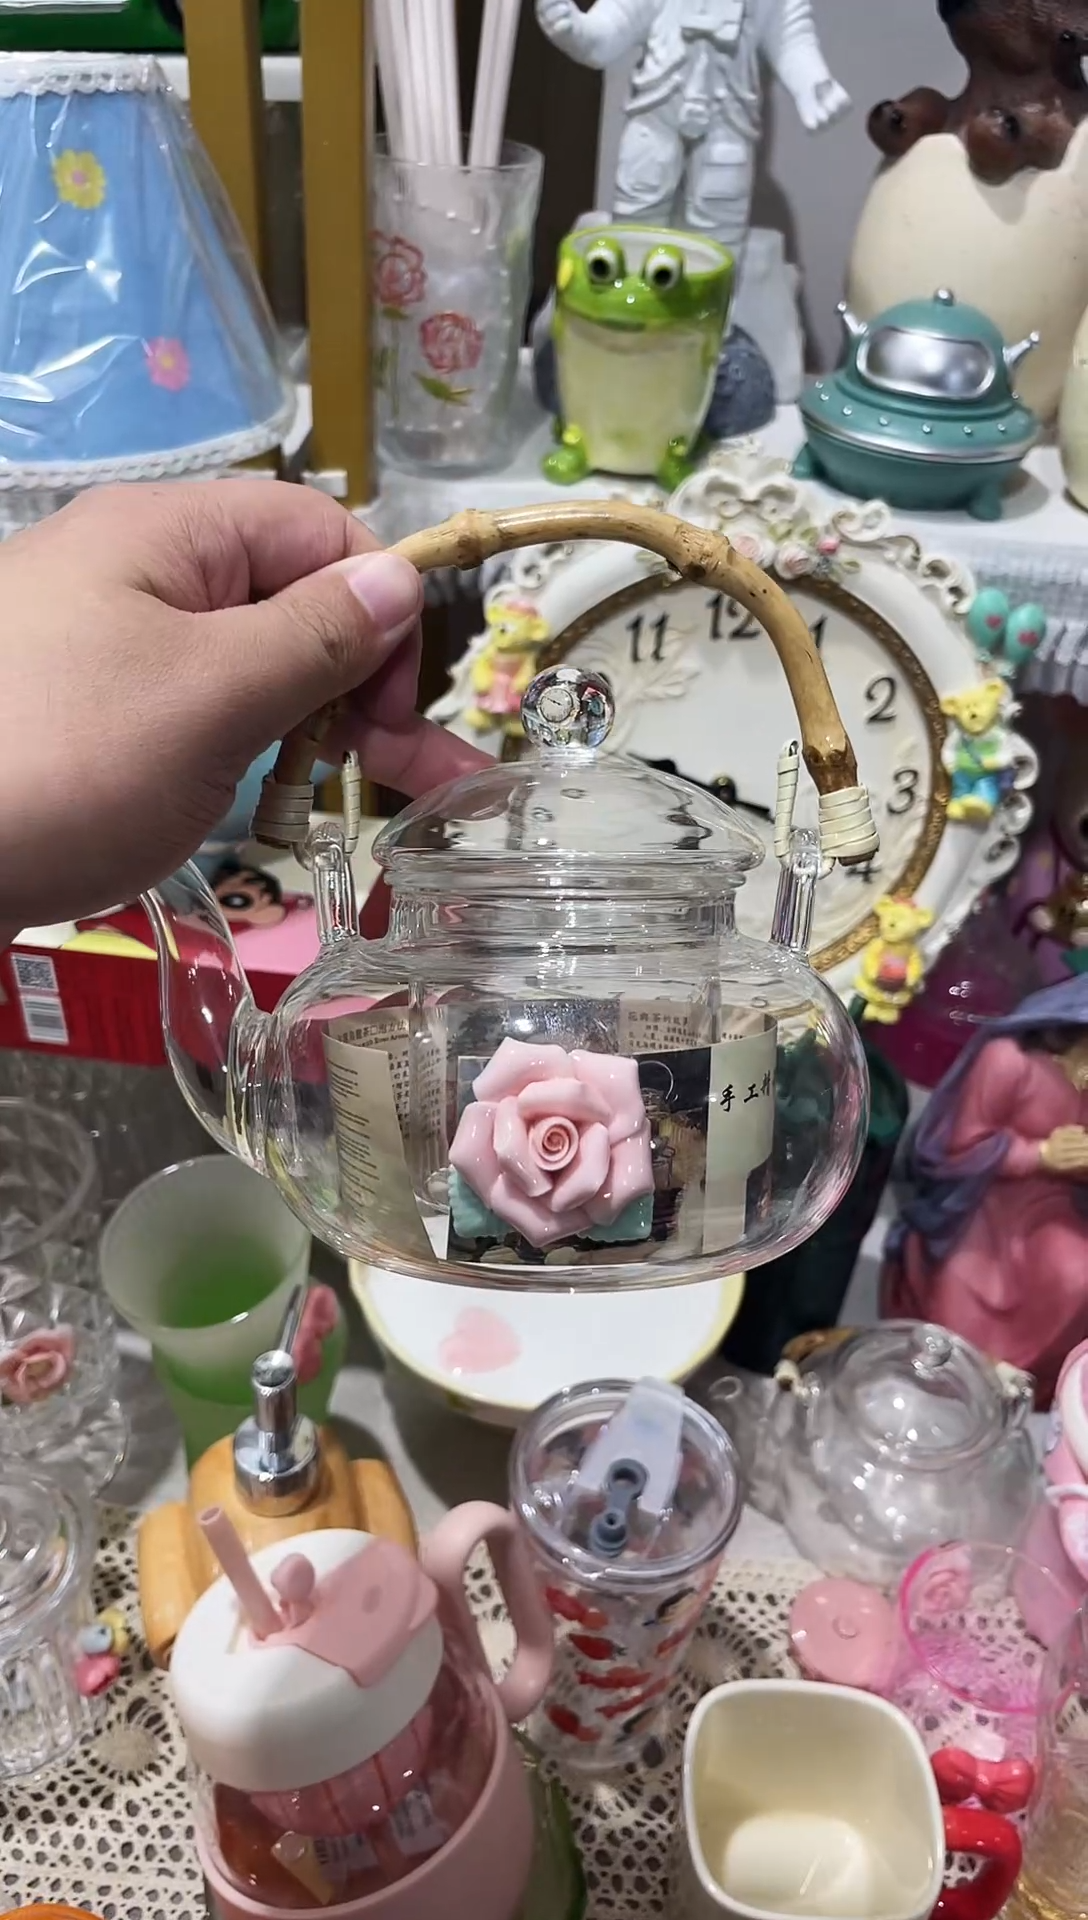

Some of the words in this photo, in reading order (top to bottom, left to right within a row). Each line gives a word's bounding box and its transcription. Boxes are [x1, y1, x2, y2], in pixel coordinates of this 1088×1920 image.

[626, 611, 669, 663] 11
[706, 591, 762, 641] 12
[865, 676, 897, 724] 2
[887, 769, 918, 814] 3
